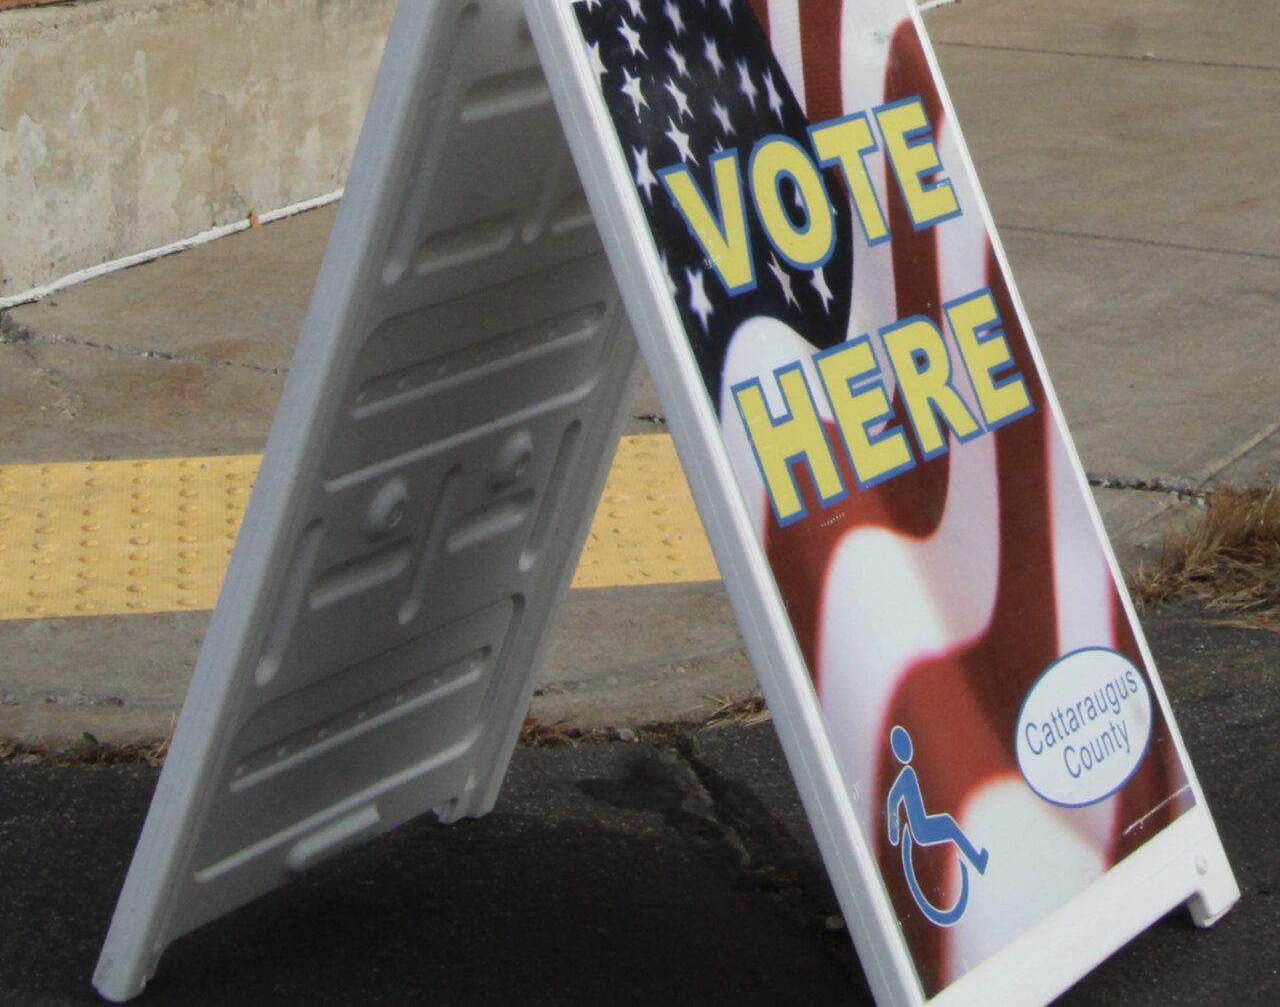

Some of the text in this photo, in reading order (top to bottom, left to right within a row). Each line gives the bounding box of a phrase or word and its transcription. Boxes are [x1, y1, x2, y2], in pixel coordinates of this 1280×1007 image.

[658, 95, 963, 296] VOTE
[731, 287, 1036, 529] HERE
[1024, 670, 1138, 756] Cattaraugus
[1063, 719, 1131, 779] County
